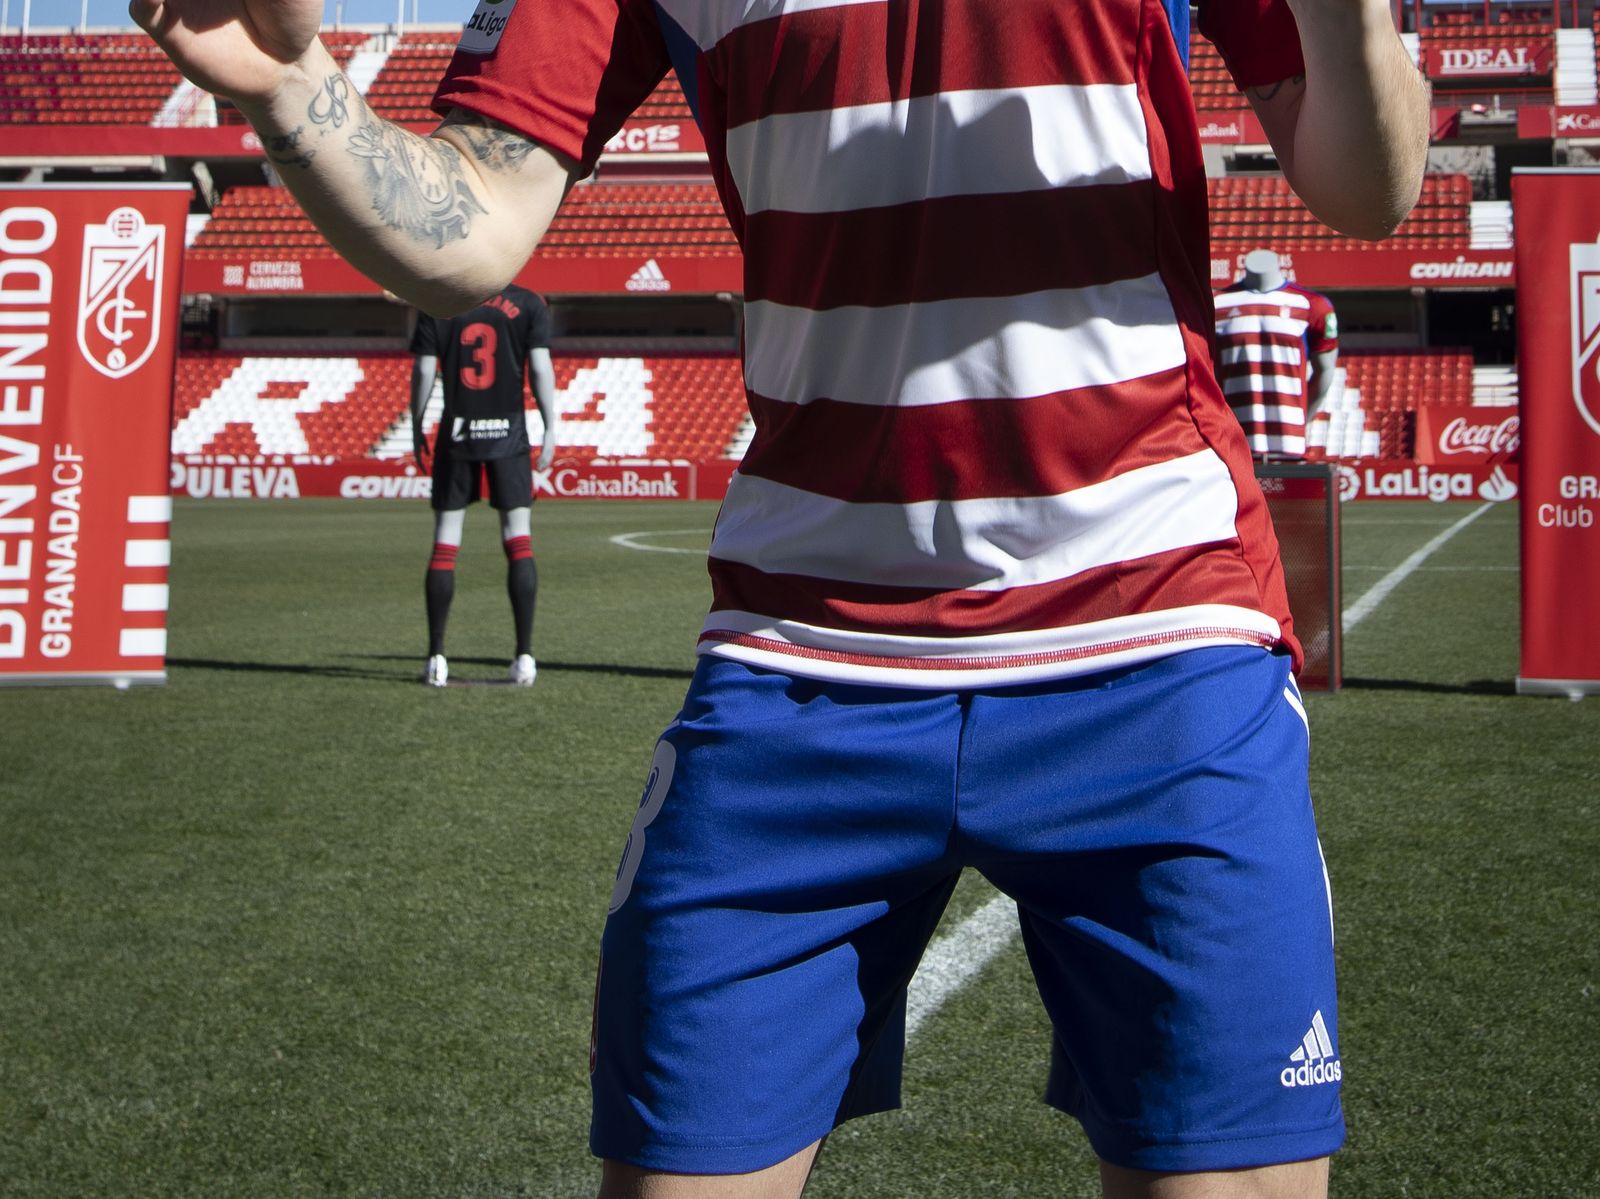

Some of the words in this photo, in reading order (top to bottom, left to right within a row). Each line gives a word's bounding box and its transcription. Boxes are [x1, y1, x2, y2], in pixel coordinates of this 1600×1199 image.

[1440, 48, 1529, 69] IDEAL
[625, 280, 671, 291] adidas
[460, 322, 498, 390] 3
[555, 468, 679, 497] CaixaBank
[1365, 465, 1473, 502] LaLiga
[1560, 475, 1600, 499] GR
[1538, 503, 1594, 528] Club
[1280, 1057, 1342, 1088] adidas
